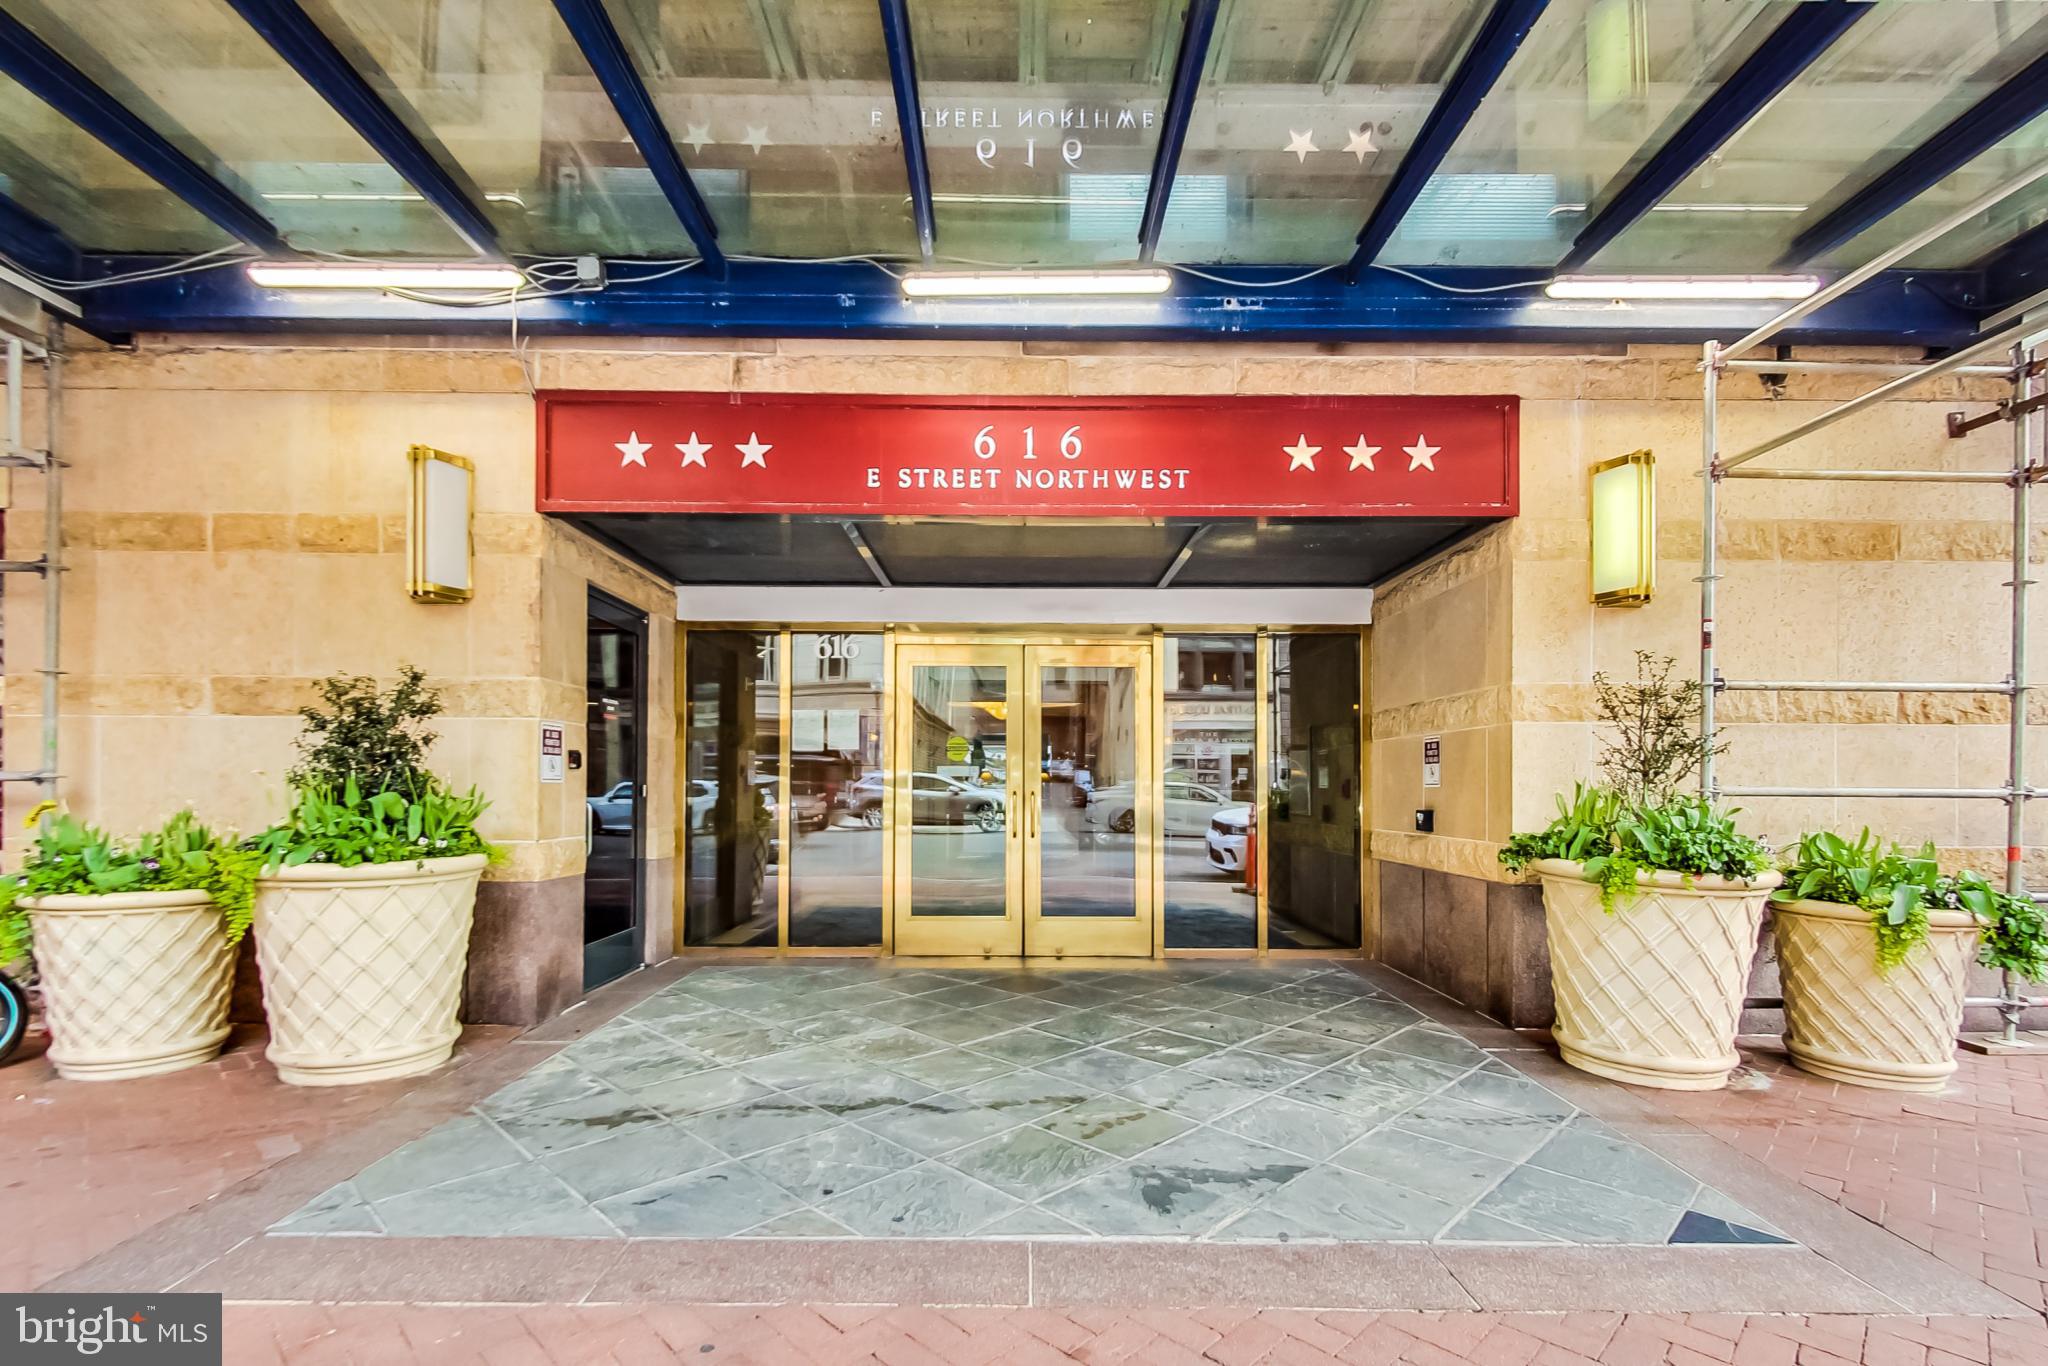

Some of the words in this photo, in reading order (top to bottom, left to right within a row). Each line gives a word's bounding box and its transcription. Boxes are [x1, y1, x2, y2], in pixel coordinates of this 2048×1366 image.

[866, 468, 881, 489] E
[898, 468, 1002, 489] STREET
[1015, 469, 1191, 490] NORTHWEST
[815, 634, 860, 659] 616
